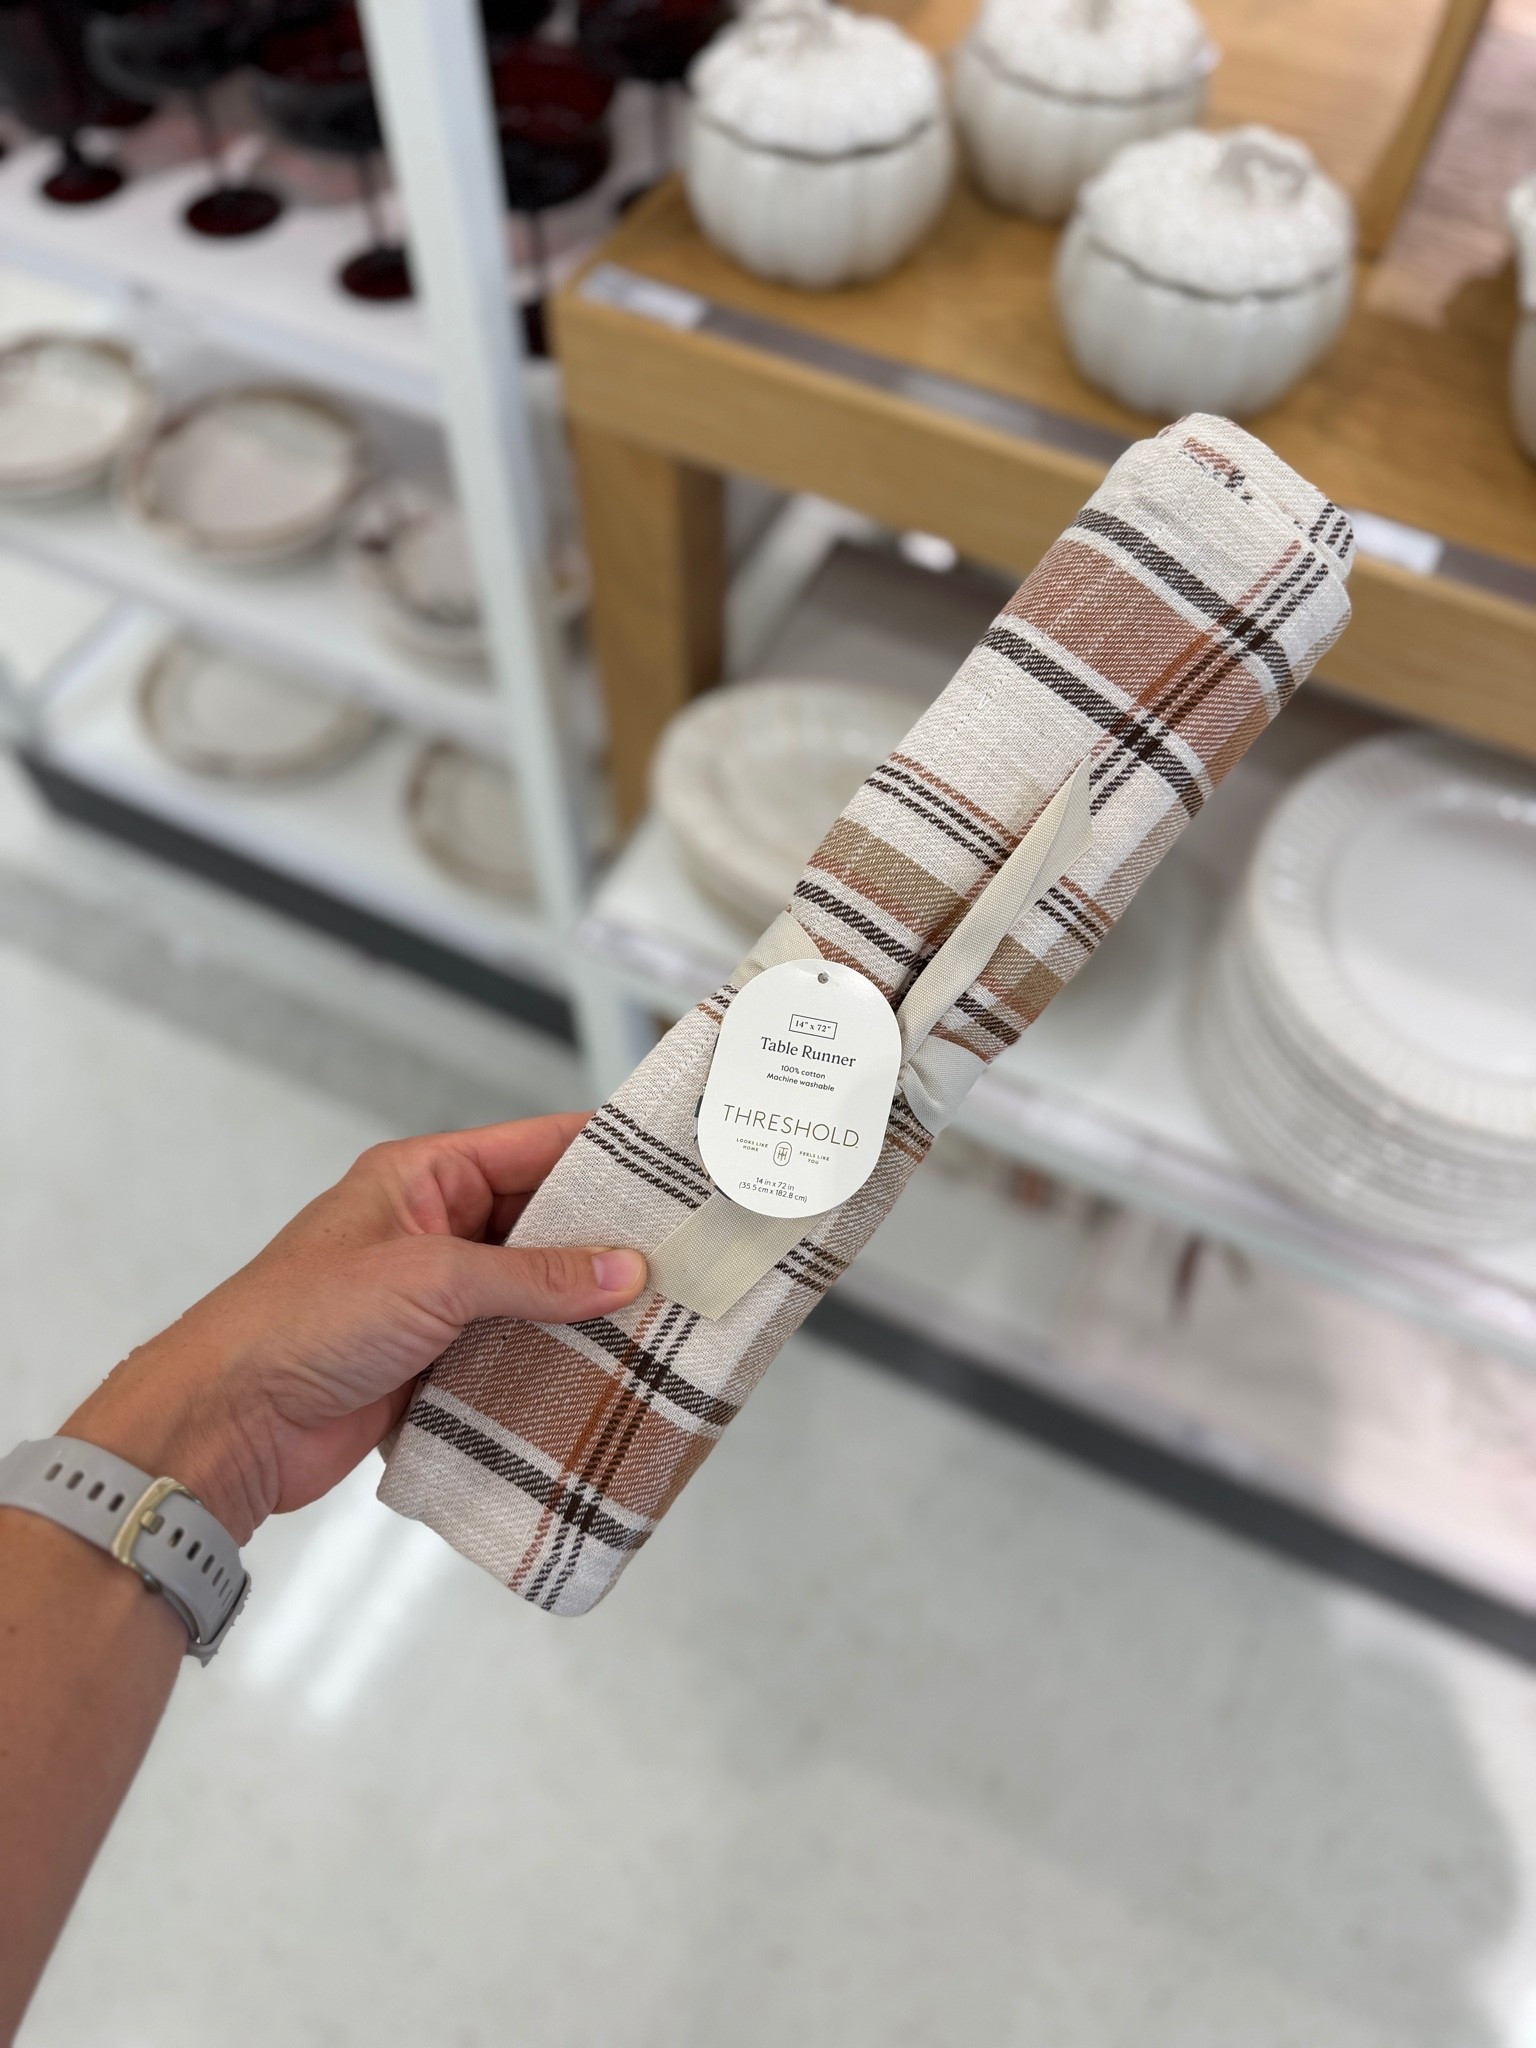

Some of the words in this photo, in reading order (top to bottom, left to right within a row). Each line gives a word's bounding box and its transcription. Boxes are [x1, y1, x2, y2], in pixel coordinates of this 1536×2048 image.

[795, 1020, 809, 1028] 14"
[817, 1024, 831, 1032] 72"
[761, 1036, 799, 1055] Table
[801, 1045, 856, 1067] Runner
[781, 1065, 800, 1074] 100%
[801, 1069, 826, 1079] cotton
[766, 1073, 798, 1084] Machine
[800, 1080, 835, 1091] washable
[724, 1104, 859, 1147] THRESHOLD
[736, 1137, 755, 1145] LOOKS
[742, 1144, 759, 1152] HOME
[799, 1151, 816, 1159] FEELS
[775, 1189, 793, 1199] 182.8
[795, 1194, 808, 1203] cm)
